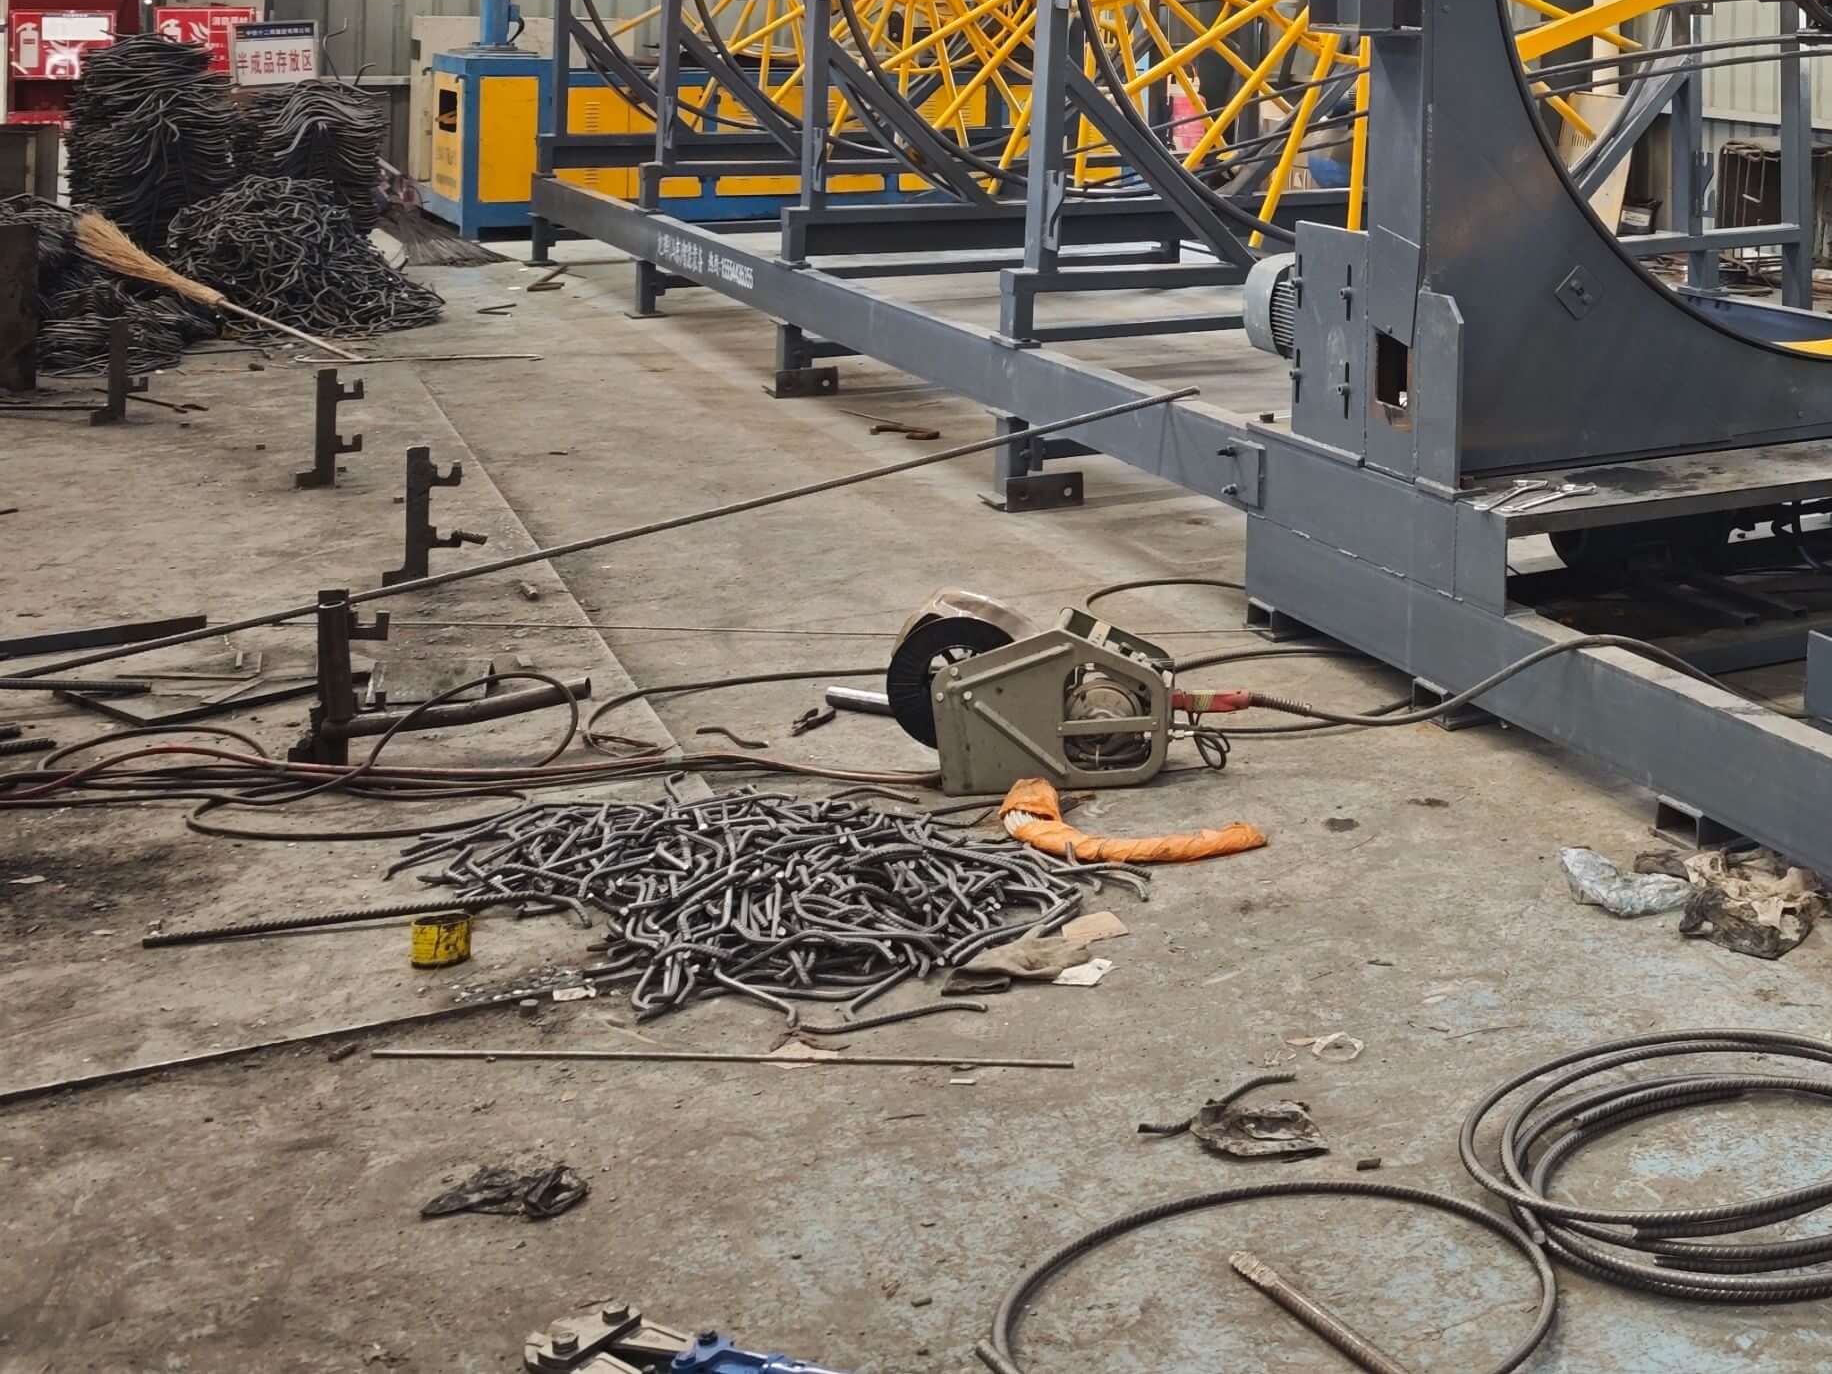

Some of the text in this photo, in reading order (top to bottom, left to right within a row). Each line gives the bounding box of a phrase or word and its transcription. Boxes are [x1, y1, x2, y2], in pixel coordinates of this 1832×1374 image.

[236, 49, 313, 75] 半成品存放区
